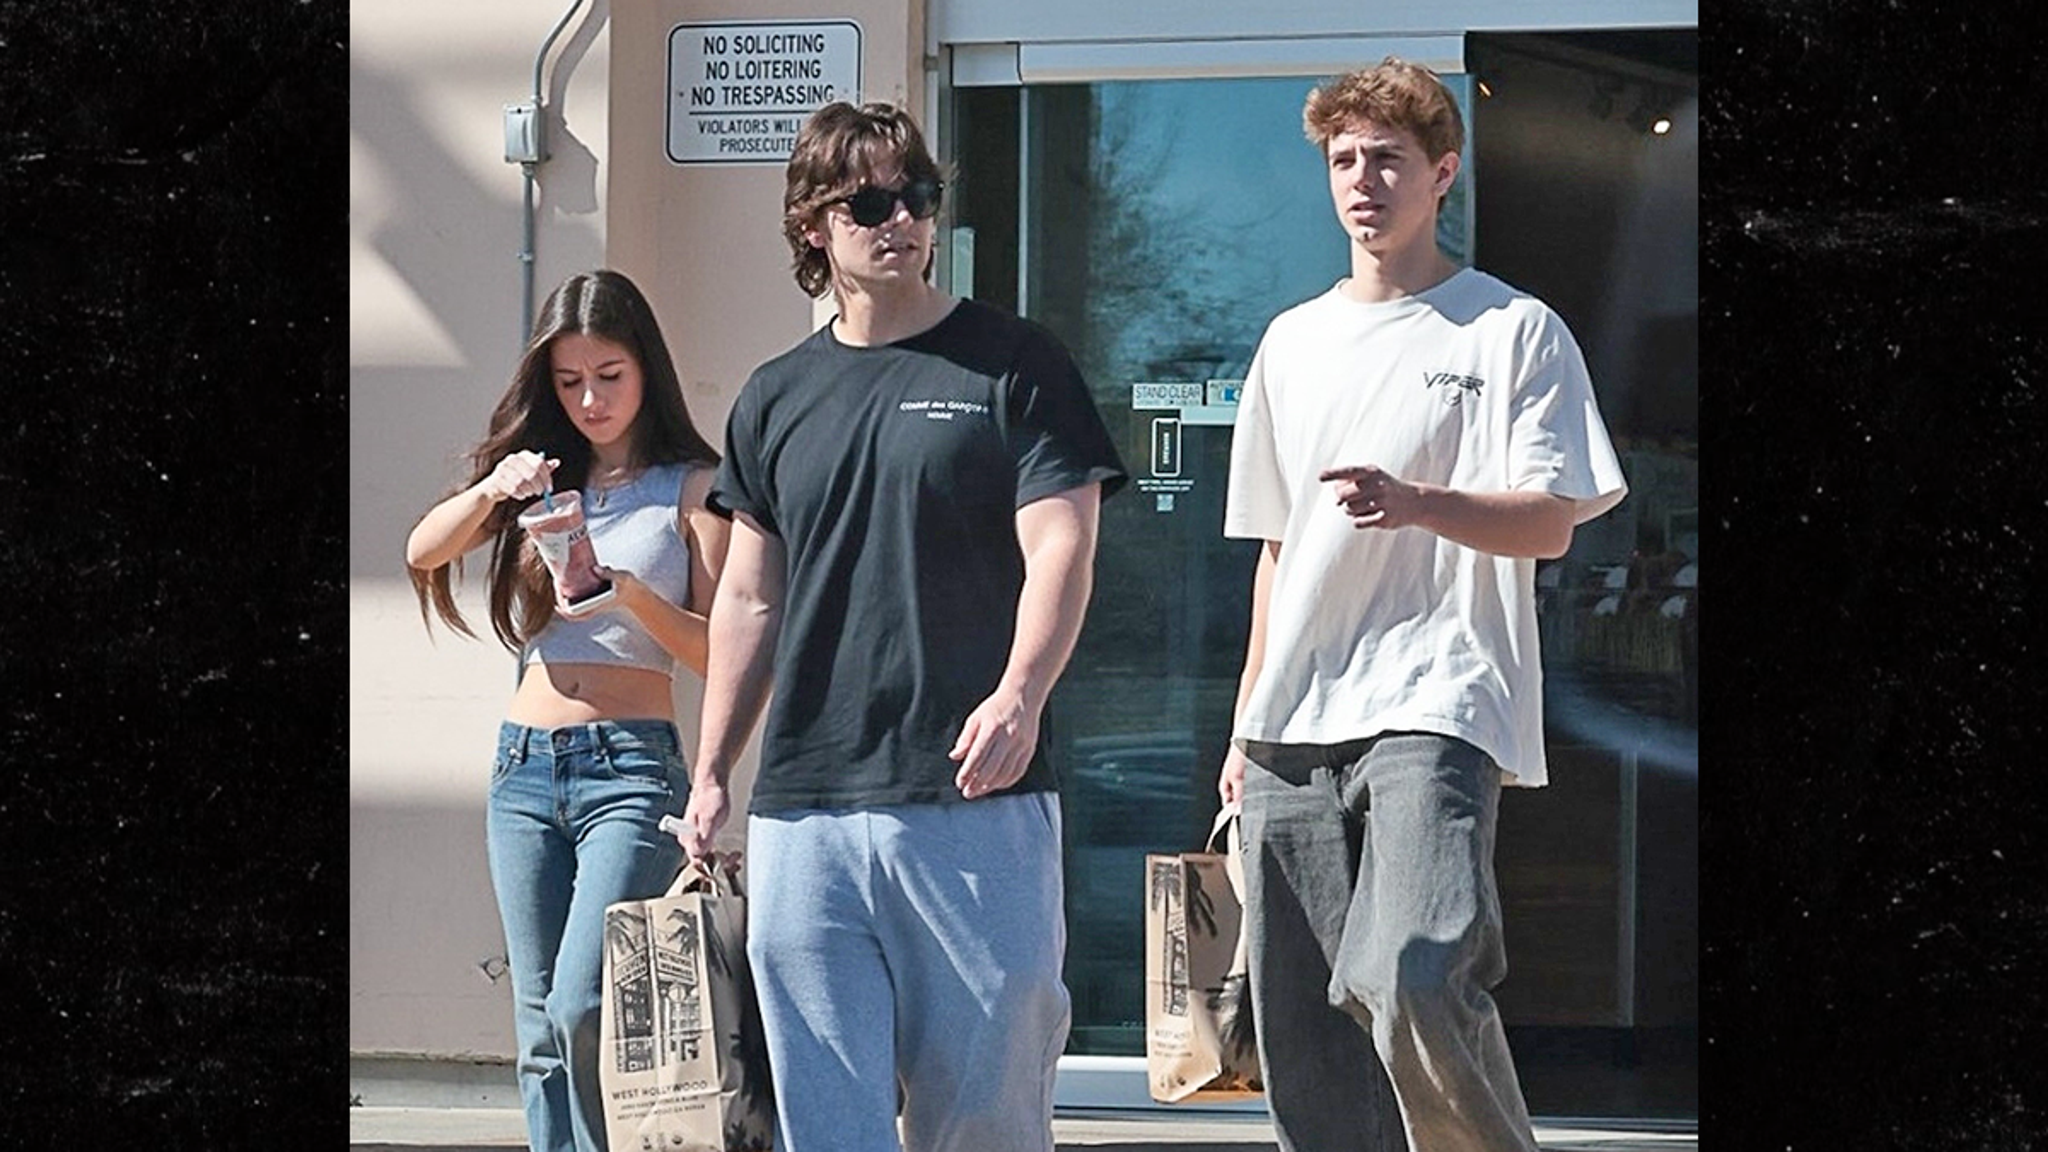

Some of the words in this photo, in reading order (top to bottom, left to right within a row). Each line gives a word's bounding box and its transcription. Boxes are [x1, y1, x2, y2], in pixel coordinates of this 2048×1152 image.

[703, 35, 728, 55] NO
[733, 34, 825, 55] SOLICITING
[705, 61, 730, 81] NO
[735, 60, 822, 80] LOITERING
[691, 87, 715, 106] NO
[721, 85, 835, 105] TRESPASSING
[698, 119, 769, 135] VIOLATORS
[719, 138, 795, 153] PROSECUTE
[1135, 385, 1167, 399] STAND
[1168, 385, 1201, 399] CLEAR
[612, 1088, 639, 1101] WEST
